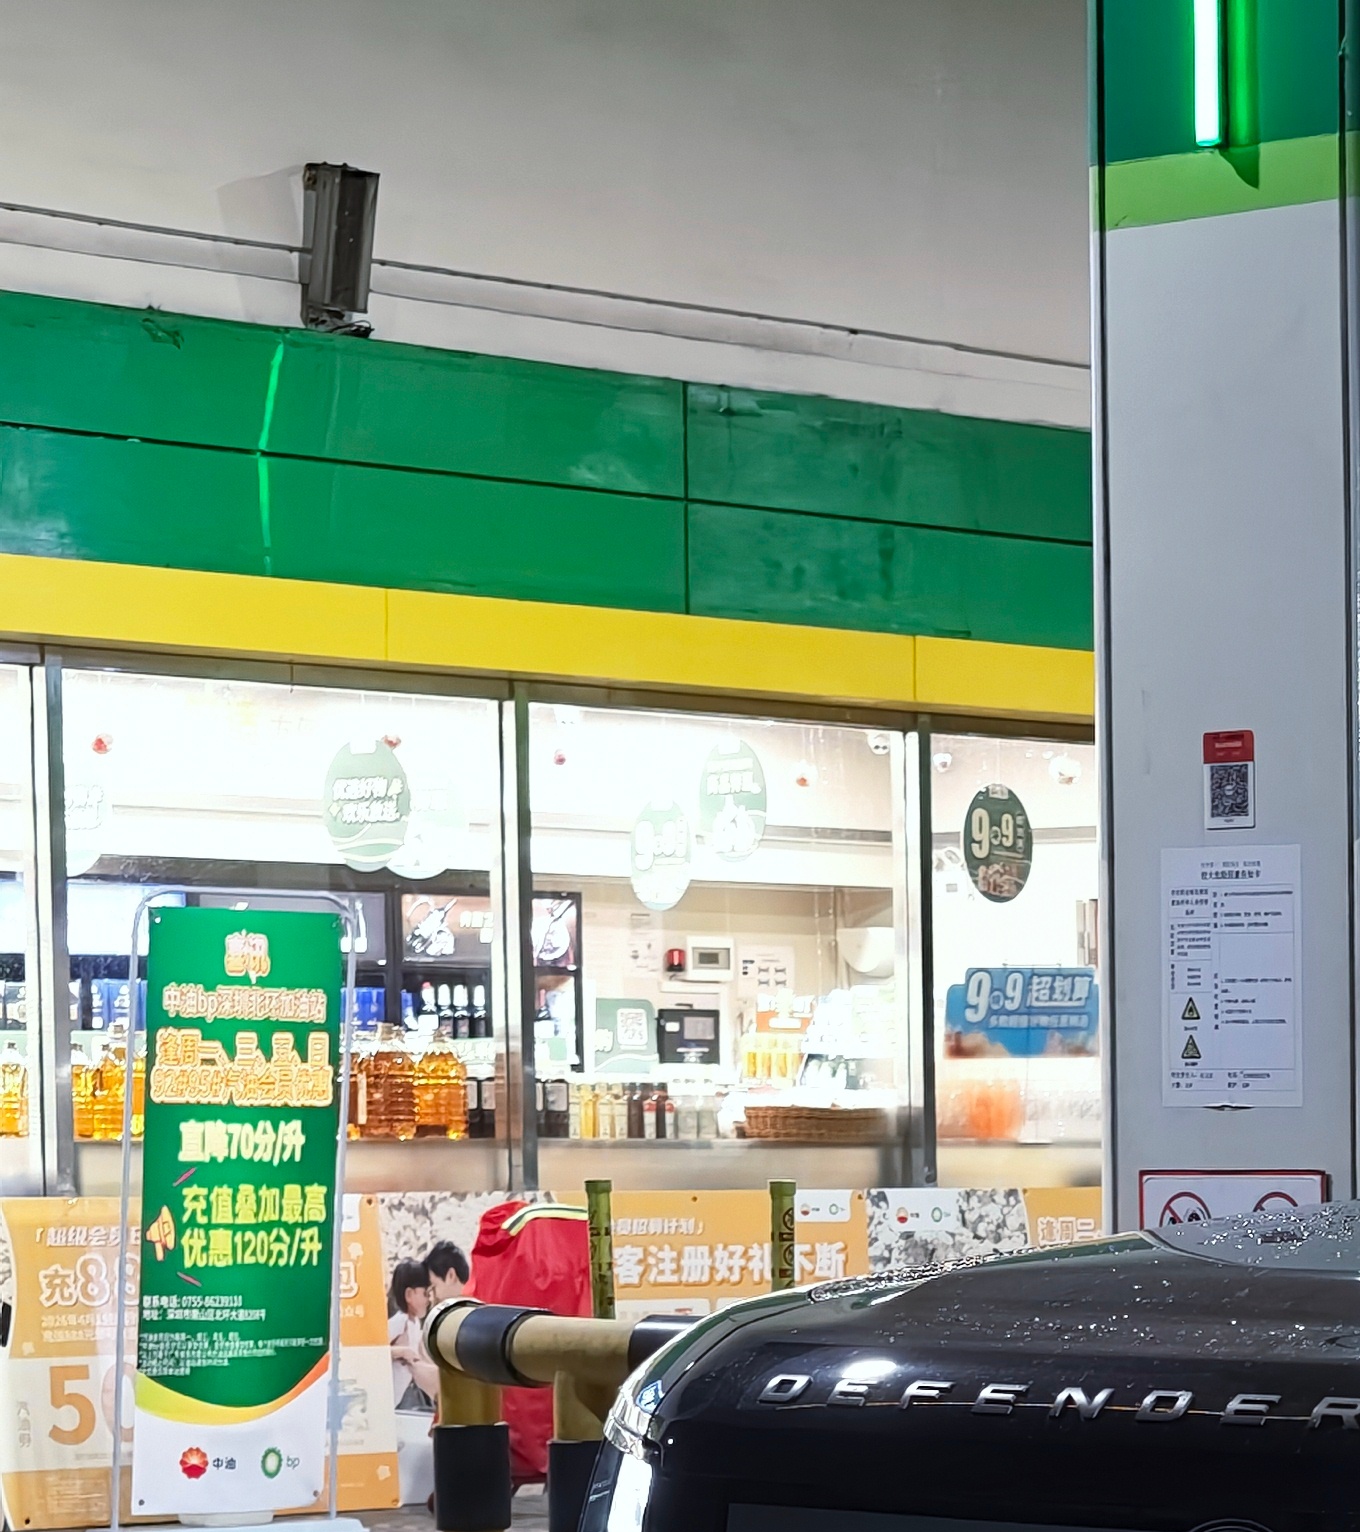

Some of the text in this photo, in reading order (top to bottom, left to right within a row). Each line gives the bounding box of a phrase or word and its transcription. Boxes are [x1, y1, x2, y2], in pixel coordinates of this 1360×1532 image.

[178, 1119, 306, 1166] 直降70分/升
[181, 1183, 328, 1224] 充值叠加最高
[181, 1226, 322, 1268] 优惠120分/升
[212, 1457, 236, 1470] 中油
[286, 1456, 301, 1469] bp
